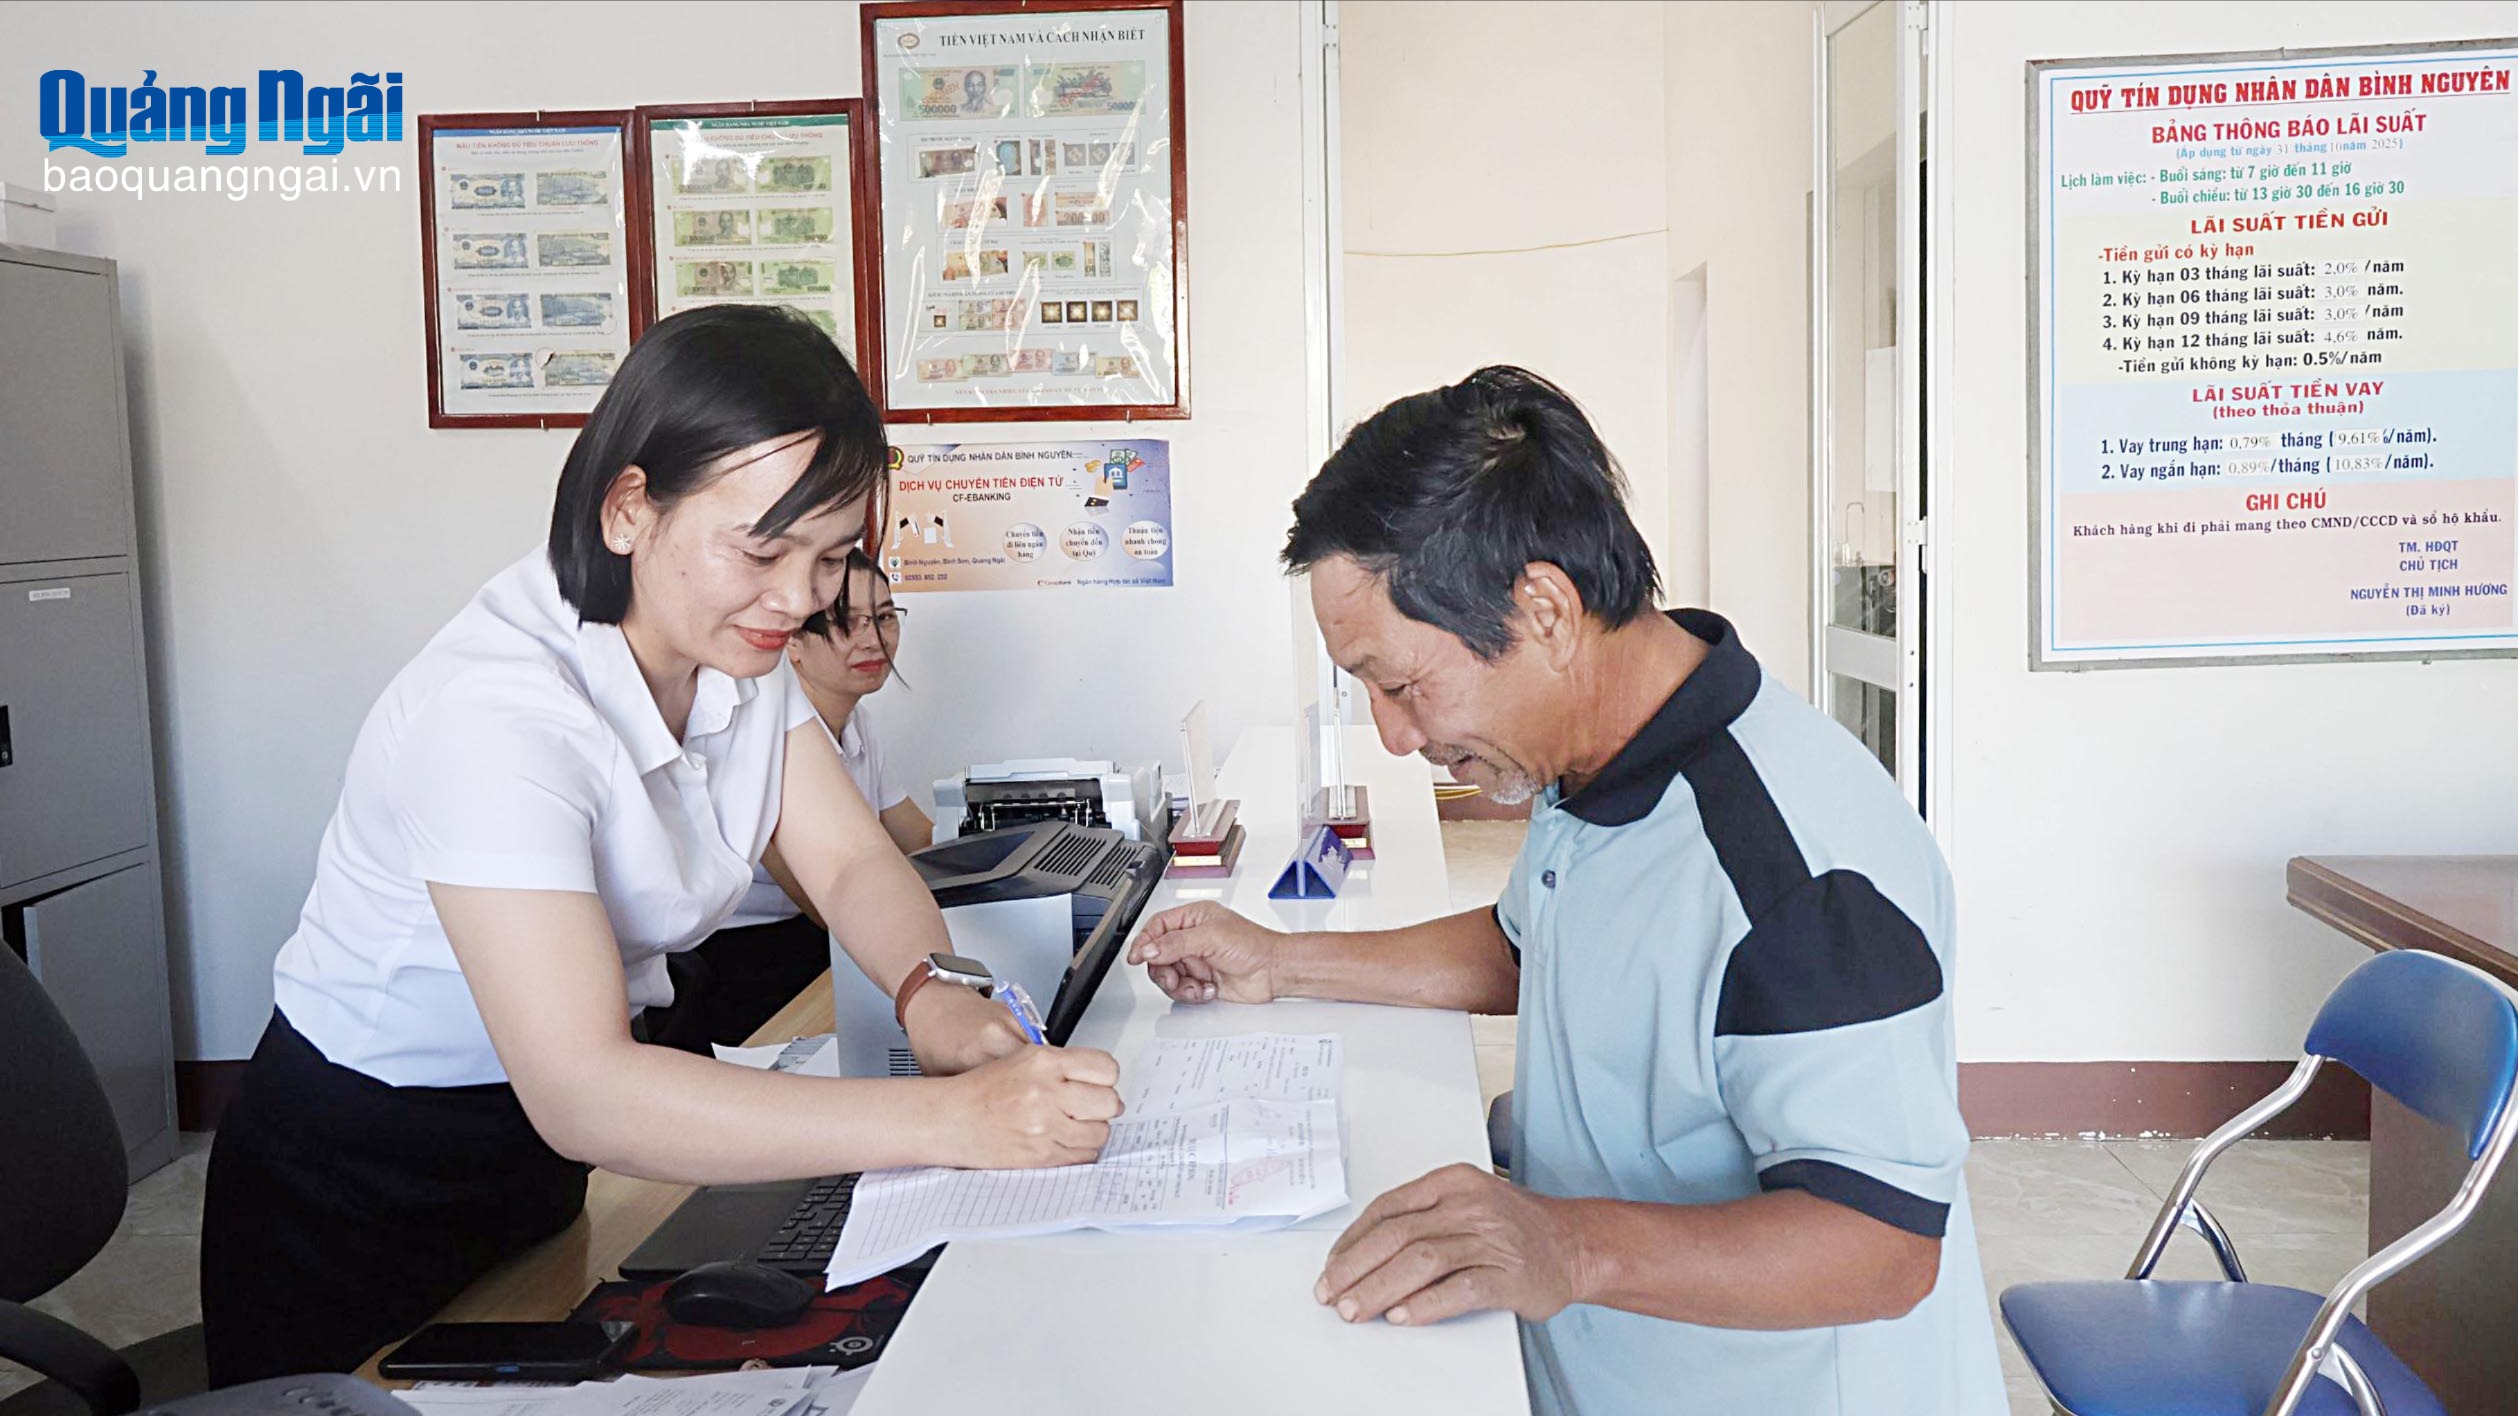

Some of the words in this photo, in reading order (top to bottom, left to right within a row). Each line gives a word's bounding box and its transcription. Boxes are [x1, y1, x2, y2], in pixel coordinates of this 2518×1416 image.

[970, 32, 997, 48] VIỆT
[1000, 33, 1025, 45] NAM
[1028, 30, 1044, 44] VÀ
[1082, 29, 1114, 44] NHẬN
[1118, 27, 1145, 41] BIẾT
[2071, 84, 2112, 112] QUỸ
[2121, 82, 2160, 108] TÍN
[2168, 83, 2227, 110] DỤNG
[2236, 76, 2297, 102] NHÂN
[2305, 73, 2350, 99] DÂN
[2359, 70, 2413, 97] BÌNH
[2421, 65, 2511, 93] NGUYÊN
[2152, 119, 2207, 143] BẢNG
[2213, 118, 2281, 140] THÔNG
[2288, 114, 2330, 138] BÁO
[2337, 113, 2369, 135] LÃI
[2376, 108, 2427, 133] SUẤT
[2200, 147, 2227, 160] dụng
[2246, 145, 2272, 157] ngày
[2295, 142, 2327, 153] tháng
[2061, 174, 2086, 190] Lịch
[2091, 173, 2113, 186] làm
[2118, 171, 2146, 187] việc:
[2160, 165, 2188, 182] Buổi
[2193, 167, 2226, 184] sáng:
[2230, 165, 2244, 179] từ
[2248, 165, 2255, 179] 7
[2259, 163, 2280, 181] giờ
[2283, 162, 2306, 176] đến
[2312, 162, 2327, 176] 11
[2332, 161, 2351, 177] giờ
[2160, 187, 2189, 204] Buổi
[2234, 187, 2248, 201] từ
[2253, 187, 2268, 200] 13
[2272, 185, 2292, 202] giờ
[2296, 185, 2312, 199] 30
[2317, 183, 2340, 197] đến
[2345, 182, 2360, 196] 16
[2365, 181, 2384, 197] giờ
[2388, 181, 2404, 194] 30
[2191, 215, 2225, 234] LÃI
[2232, 210, 2287, 232] SUẤT
[2295, 208, 2345, 229] TIỀN
[2352, 206, 2388, 227] GỬI
[2144, 245, 2169, 263] gửi
[2174, 245, 2194, 259] có
[2200, 243, 2218, 260] kỳ
[2225, 242, 2254, 260] hạn
[2103, 271, 2116, 284] 1.
[2122, 270, 2141, 286] Kỳ
[2147, 269, 2175, 285] hạn
[2180, 267, 2200, 281] 03
[2205, 266, 2248, 281] tháng
[2254, 264, 2272, 278] lãi
[2277, 261, 2315, 277] suất:
[2102, 294, 2116, 307] 2.
[2122, 292, 2141, 308] Kỳ
[2147, 292, 2175, 307] hạn
[2180, 290, 2200, 303] 06
[2205, 288, 2248, 303] tháng
[2254, 287, 2272, 301] lãi
[2277, 284, 2315, 299] suất:
[2367, 283, 2404, 296] năm.
[2102, 315, 2116, 329] 3.
[2122, 314, 2141, 330] Kỳ
[2147, 313, 2175, 329] hạn
[2180, 311, 2200, 325] 09
[2205, 310, 2248, 325] tháng
[2253, 309, 2272, 322] lãi
[2277, 306, 2315, 321] suất:
[2102, 337, 2117, 351] 4.
[2122, 336, 2141, 351] Kỳ
[2147, 336, 2175, 351] hạn
[2181, 334, 2200, 347] 12
[2205, 332, 2248, 348] tháng
[2254, 331, 2272, 345] lãi
[2277, 328, 2315, 344] suất:
[2367, 328, 2403, 341] năm.
[2161, 356, 2184, 374] gửi
[2190, 356, 2236, 371] không
[2242, 354, 2259, 370] kỳ
[2266, 354, 2297, 370] hạn:
[2192, 384, 2224, 402] LÃI
[2231, 379, 2283, 402] SUẤT
[2290, 377, 2338, 398] TIỀN
[2345, 381, 2384, 397] VAY
[2213, 405, 2256, 419] (theo
[2263, 402, 2301, 416] thỏa
[2308, 400, 2364, 417] thuận)
[2101, 439, 2114, 453] 1.
[2119, 438, 2144, 456] Vay
[2149, 438, 2188, 454] trung
[2193, 436, 2223, 454] hạn:
[2281, 432, 2322, 449] tháng
[943, 452, 966, 464] DỤNG
[2101, 464, 2115, 479] 2.
[2120, 463, 2145, 481] Vay
[2150, 459, 2185, 480] ngắn
[2190, 461, 2221, 479] hạn:
[899, 480, 924, 493] DỊCH
[927, 479, 942, 491] VỤ
[1020, 477, 1044, 490] ĐIỆN
[952, 493, 1011, 502] CF-EBANKING
[2246, 492, 2279, 511] GHI
[2286, 487, 2327, 510] CHÚ
[2073, 524, 2115, 537] Khách
[2120, 523, 2152, 537] hàng
[2157, 522, 2178, 534] khi
[2183, 521, 2196, 533] đi
[2201, 520, 2230, 535] phải
[2235, 520, 2272, 534] mang
[2277, 515, 2306, 530] theo
[2311, 515, 2398, 531] CMND/CCCD
[2402, 514, 2417, 526] và
[2422, 510, 2437, 525] sổ
[2443, 512, 2459, 526] hộ
[2399, 541, 2420, 553] TM.
[2426, 540, 2459, 552] HĐQT
[2400, 556, 2425, 571] CHỦ
[2430, 559, 2458, 573] TỊCH
[2350, 583, 2399, 600] NGUYỄN
[2404, 586, 2424, 600] THỊ
[2428, 585, 2460, 597] MINH
[2465, 583, 2508, 596] HƯƠNG
[2406, 604, 2426, 616] (Đã
[2431, 603, 2451, 617] ký)
